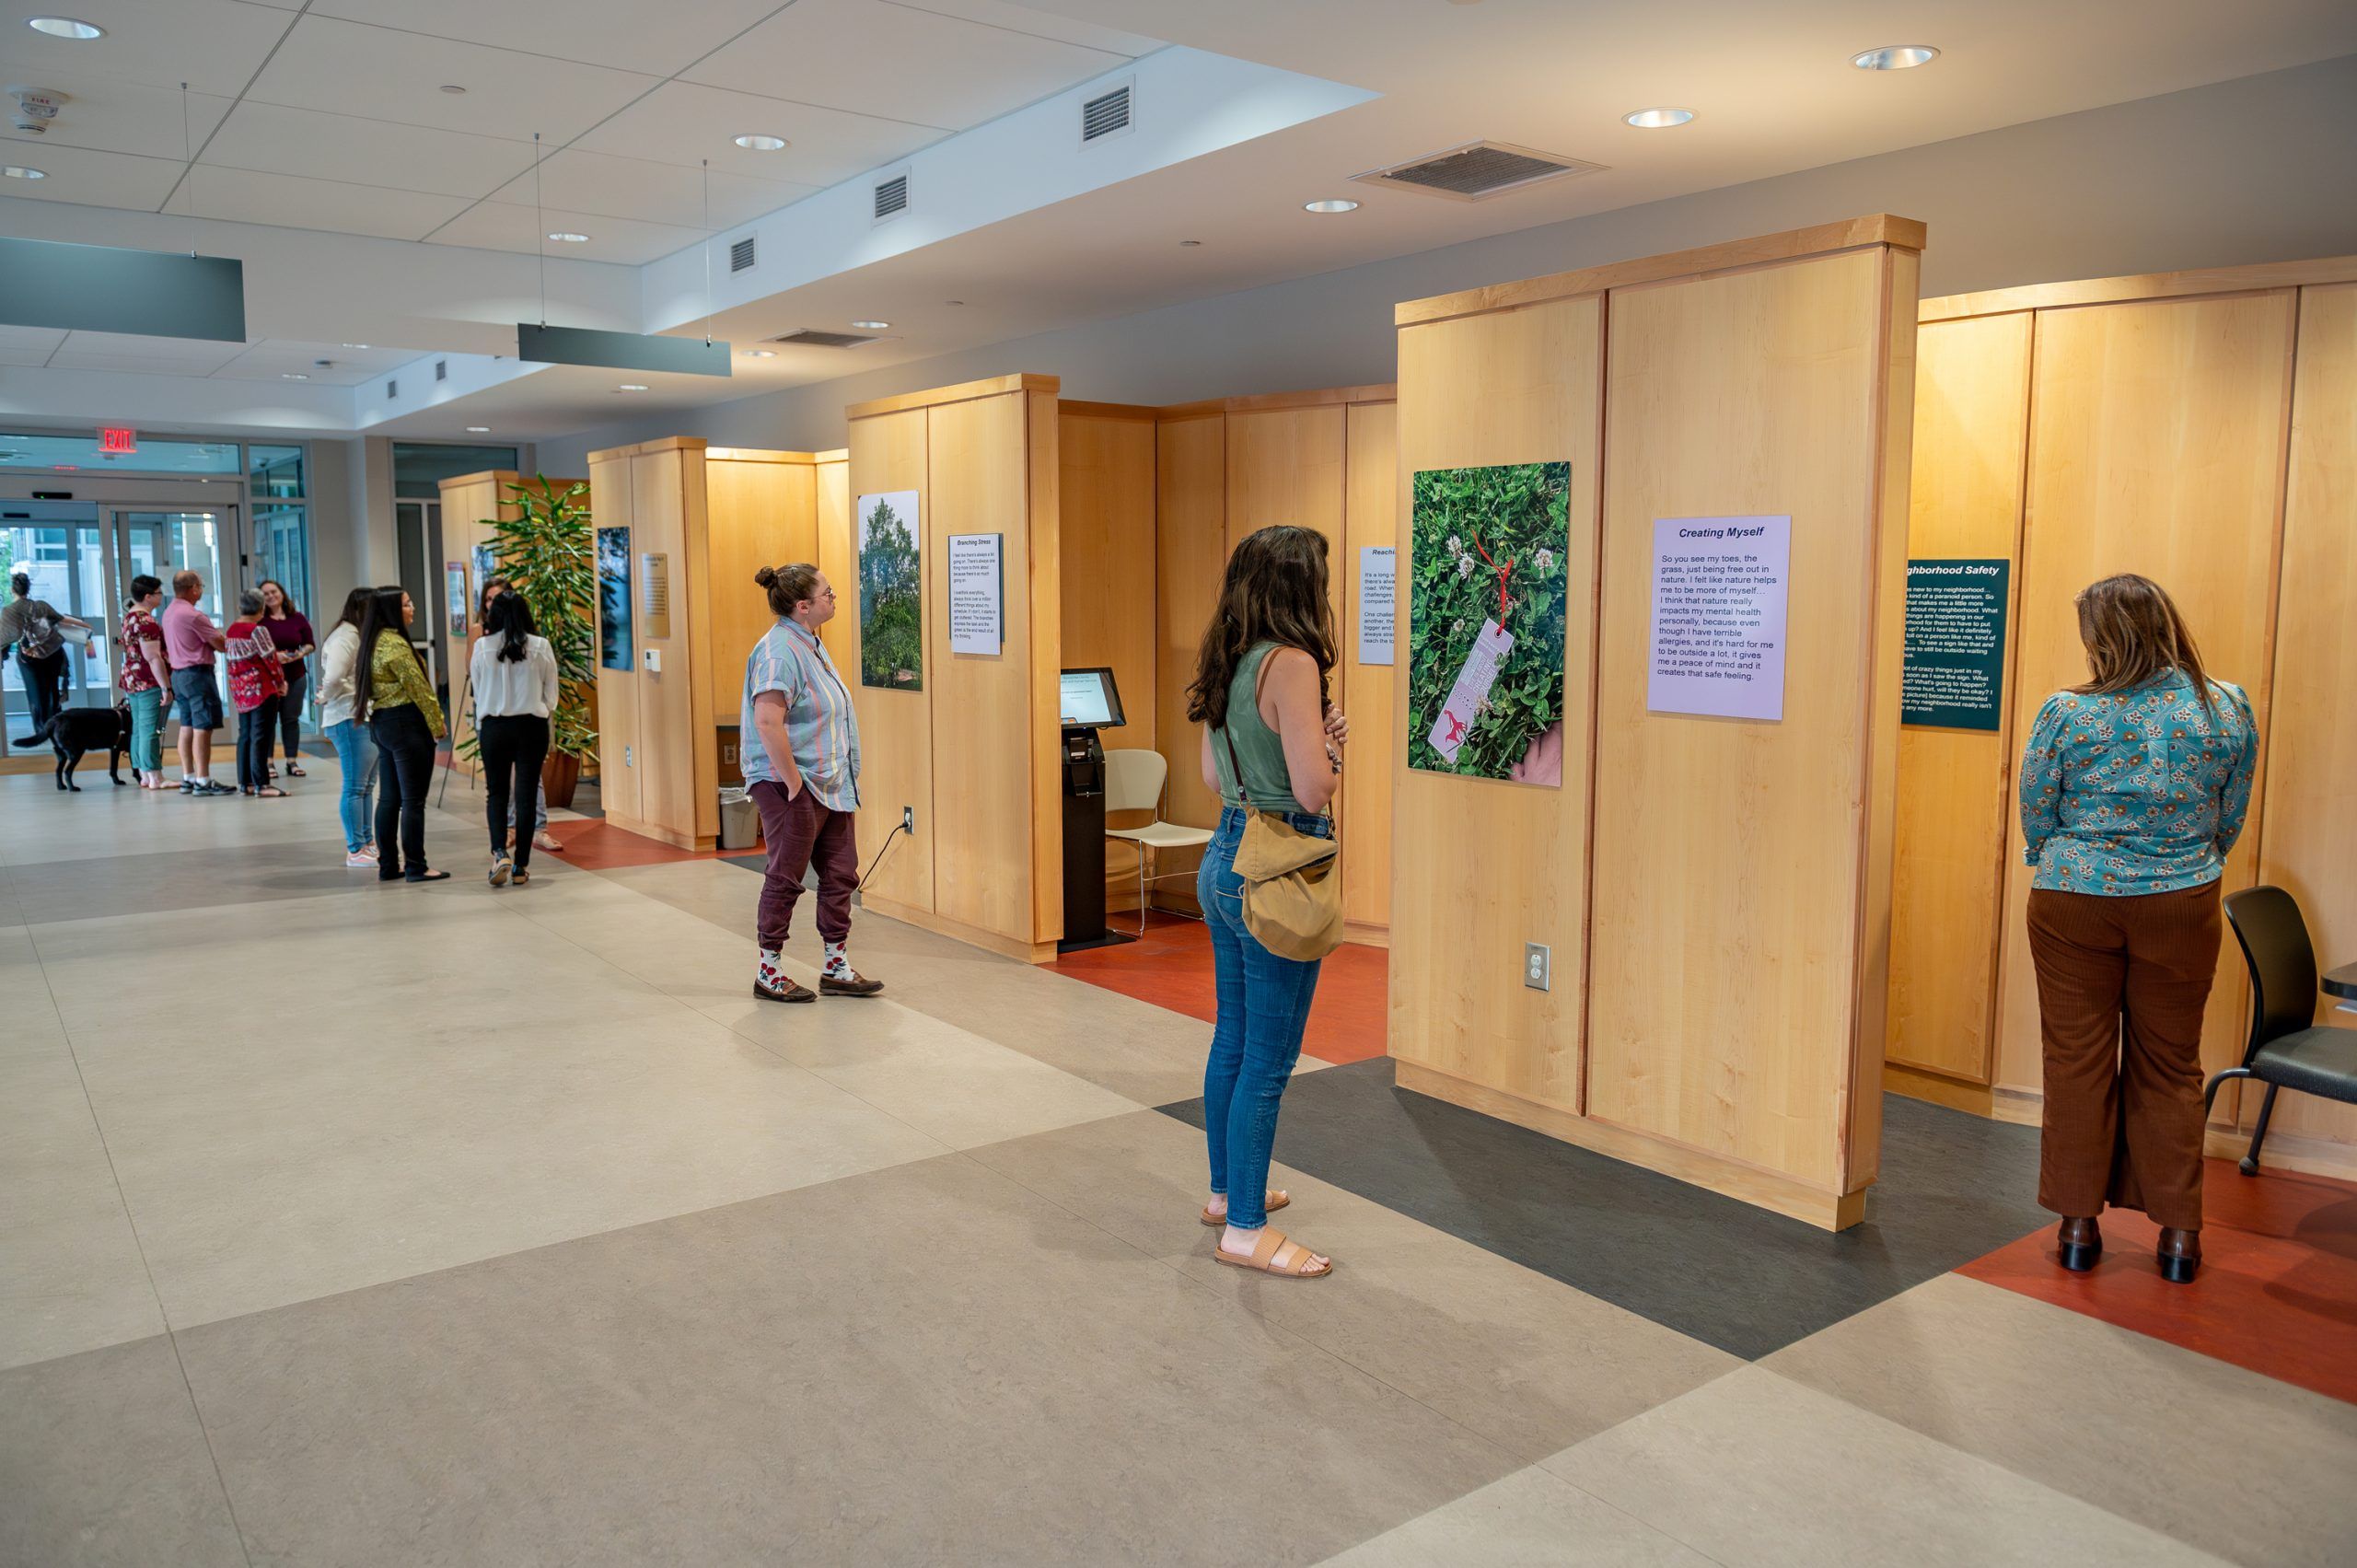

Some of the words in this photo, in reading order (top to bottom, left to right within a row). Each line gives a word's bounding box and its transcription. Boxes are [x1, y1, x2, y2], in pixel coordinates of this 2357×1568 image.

[105, 429, 131, 449] EXIT
[1679, 528, 1724, 539] Creating
[1727, 526, 1765, 539] Myself
[1687, 565, 1701, 574] just
[1703, 565, 1725, 575] being
[1907, 566, 1963, 575] ghborhood
[1965, 566, 1999, 575] Safety
[1754, 576, 1777, 585] helps
[1730, 597, 1753, 606] really
[1659, 617, 1700, 627] personally,
[1703, 618, 1737, 626] because
[1659, 627, 1685, 636] though
[1658, 637, 1693, 647] allergies,
[1717, 650, 1729, 658] lot,
[1724, 671, 1754, 682] feeling.
